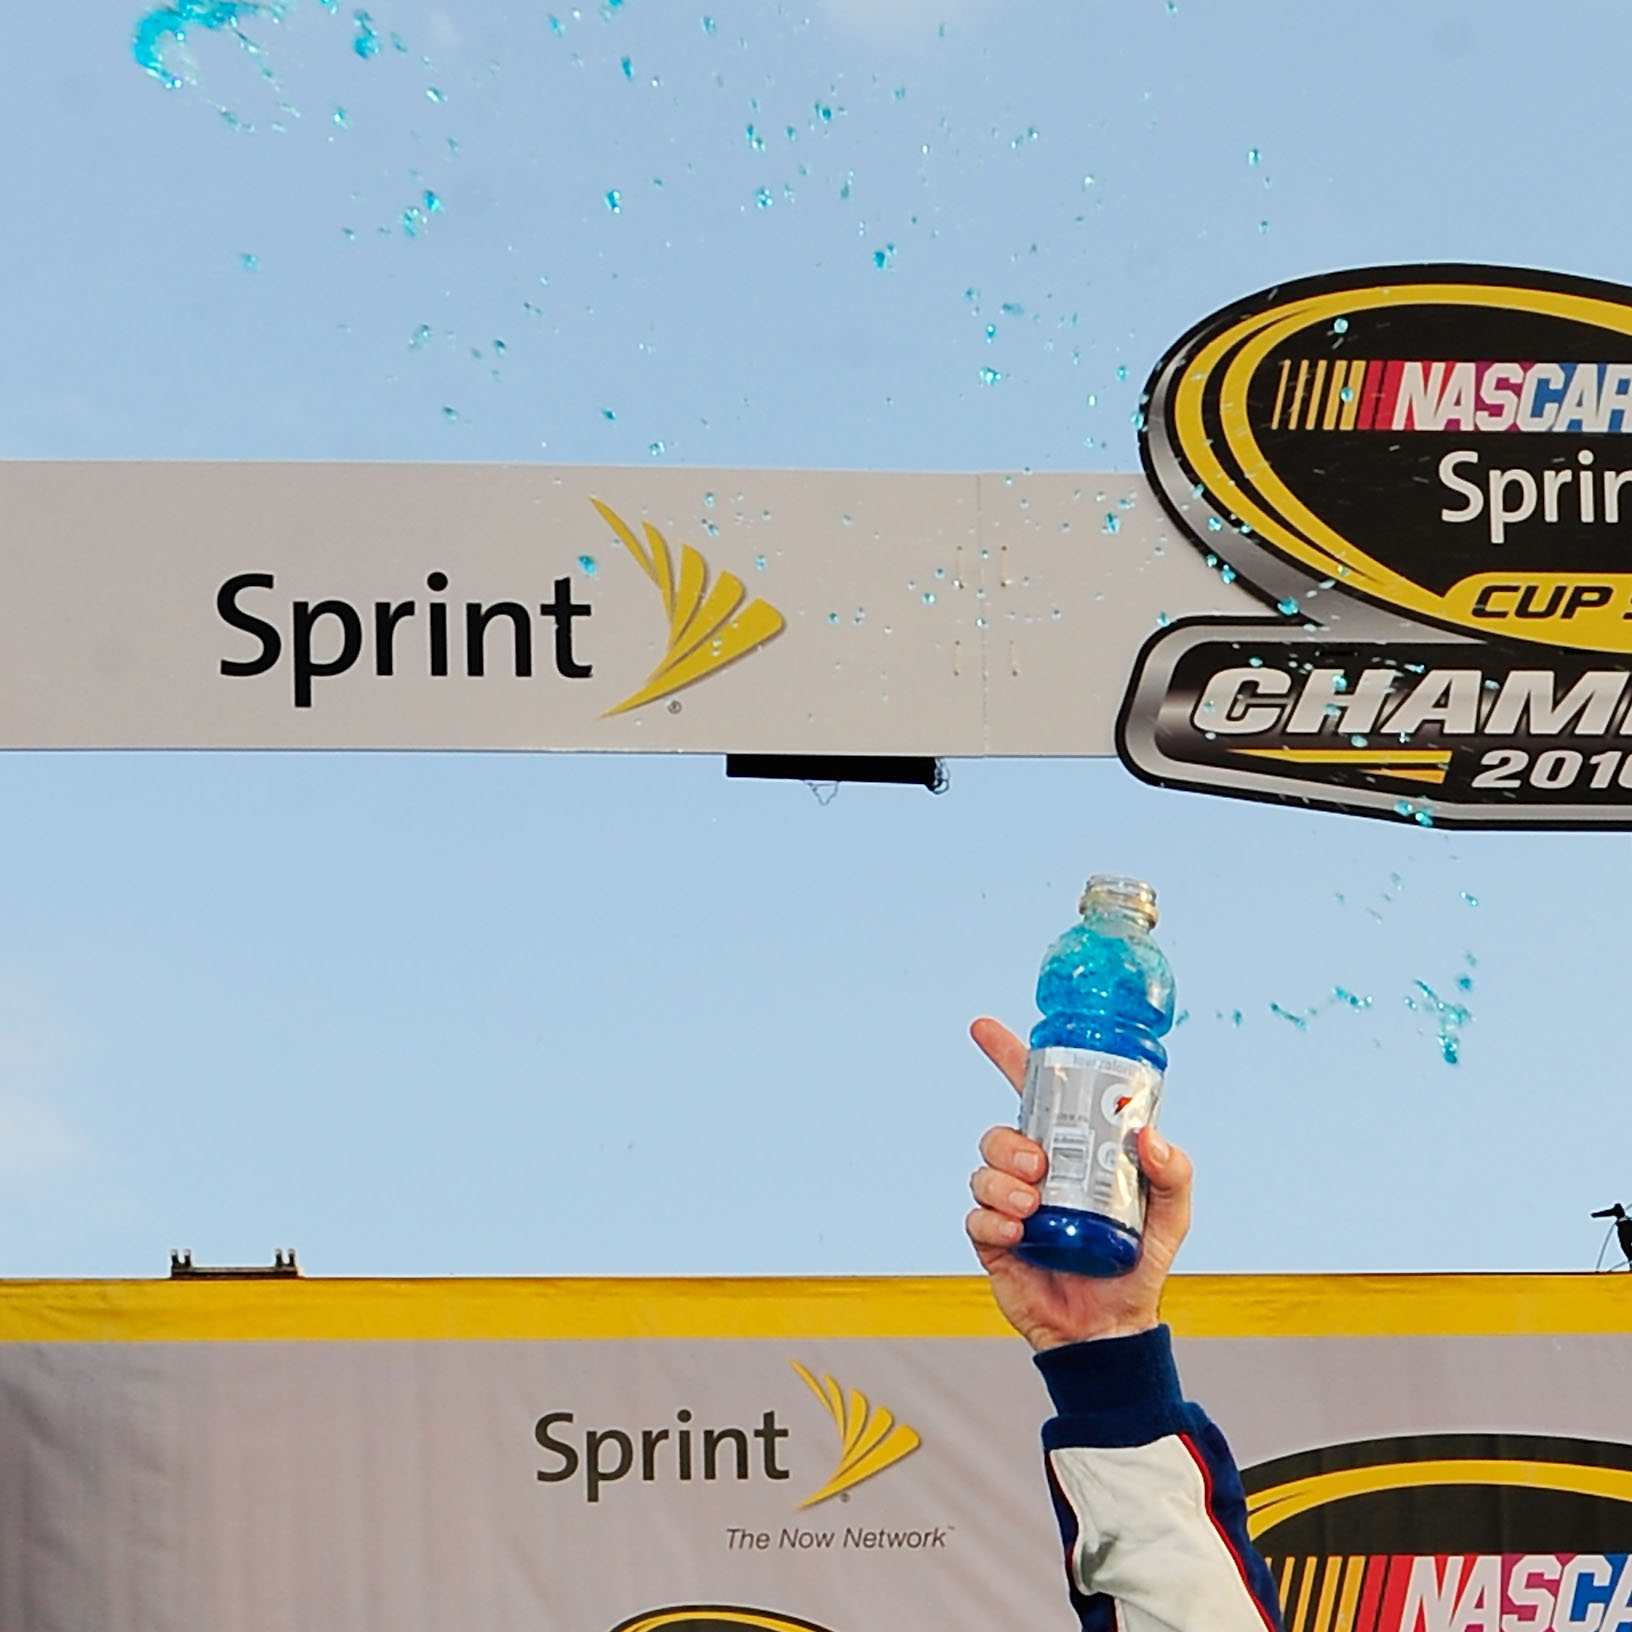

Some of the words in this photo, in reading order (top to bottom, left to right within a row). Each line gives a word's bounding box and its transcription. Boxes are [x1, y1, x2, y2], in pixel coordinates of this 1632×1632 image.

[1470, 586, 1614, 621] CUP
[213, 570, 595, 708] Sprint
[533, 1409, 791, 1503] Sprint
[725, 1527, 773, 1552] The
[779, 1527, 835, 1550] Now
[842, 1526, 947, 1550] Network
